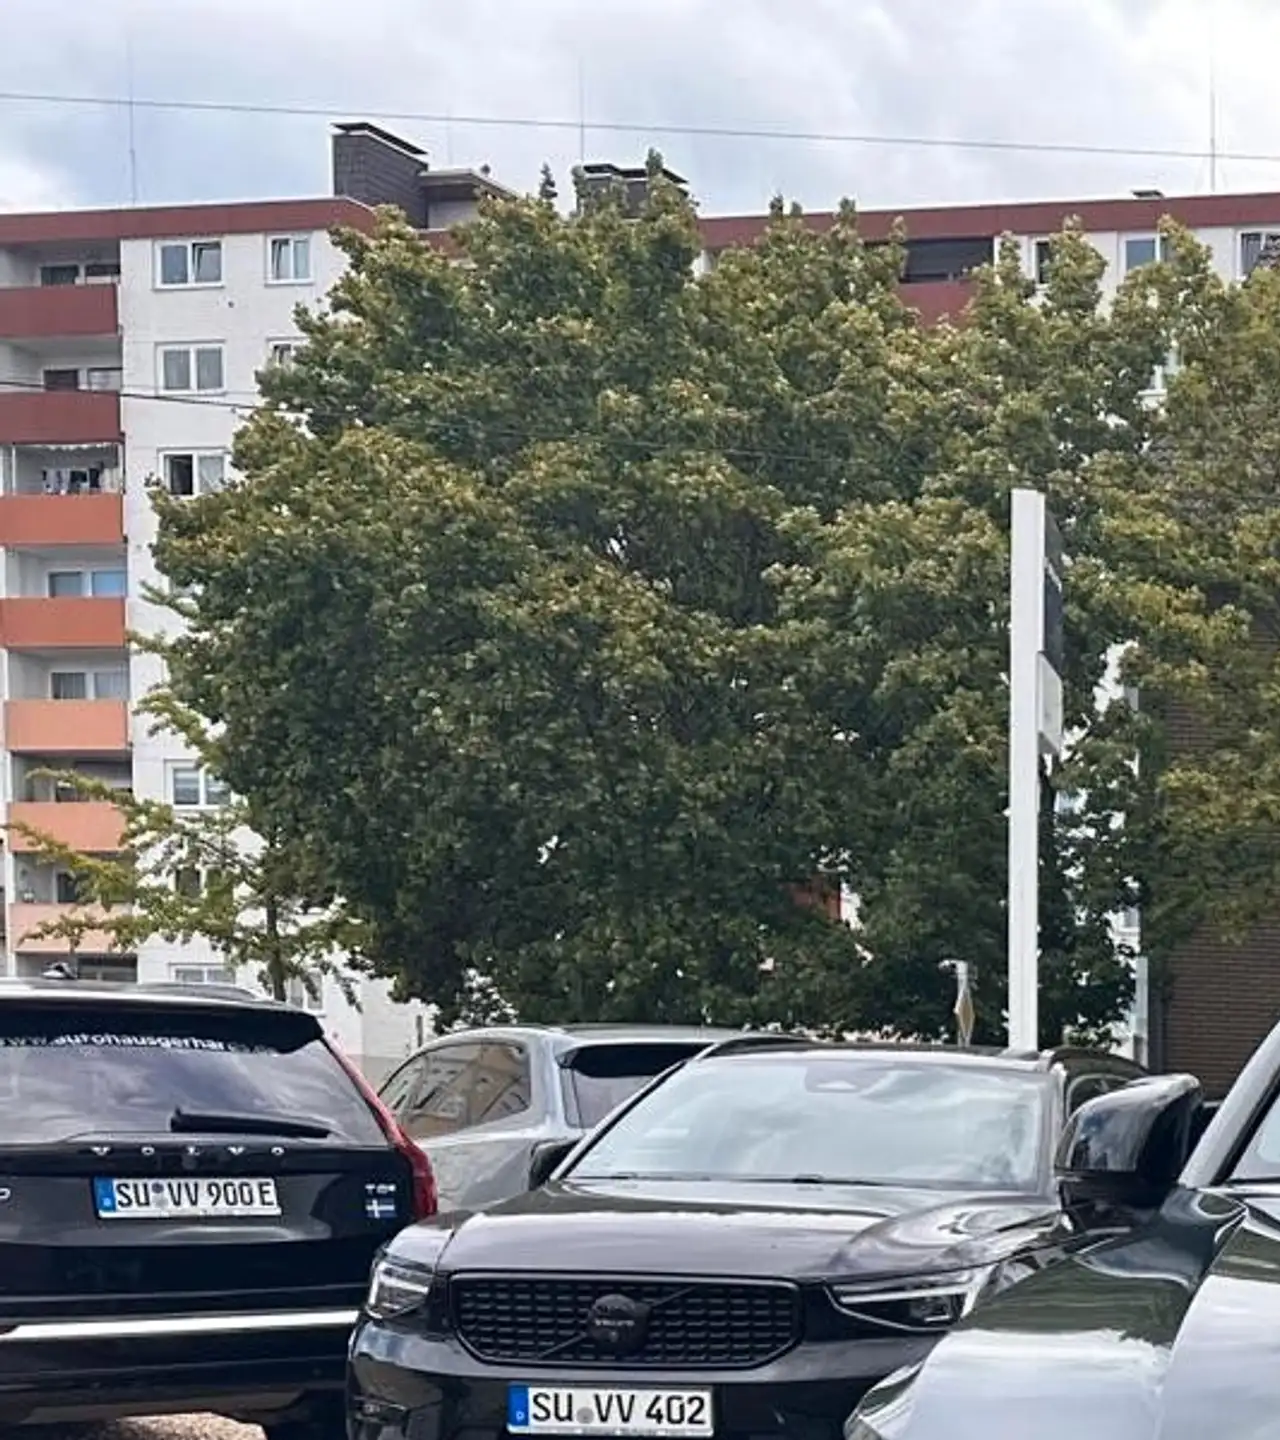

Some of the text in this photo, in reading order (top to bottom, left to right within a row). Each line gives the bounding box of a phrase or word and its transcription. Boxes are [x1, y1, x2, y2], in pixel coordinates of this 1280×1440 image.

[91, 1145, 284, 1156] VOLVO
[116, 1182, 150, 1207] SU
[167, 1182, 199, 1207] VV
[532, 1392, 706, 1425] SU VV 402
